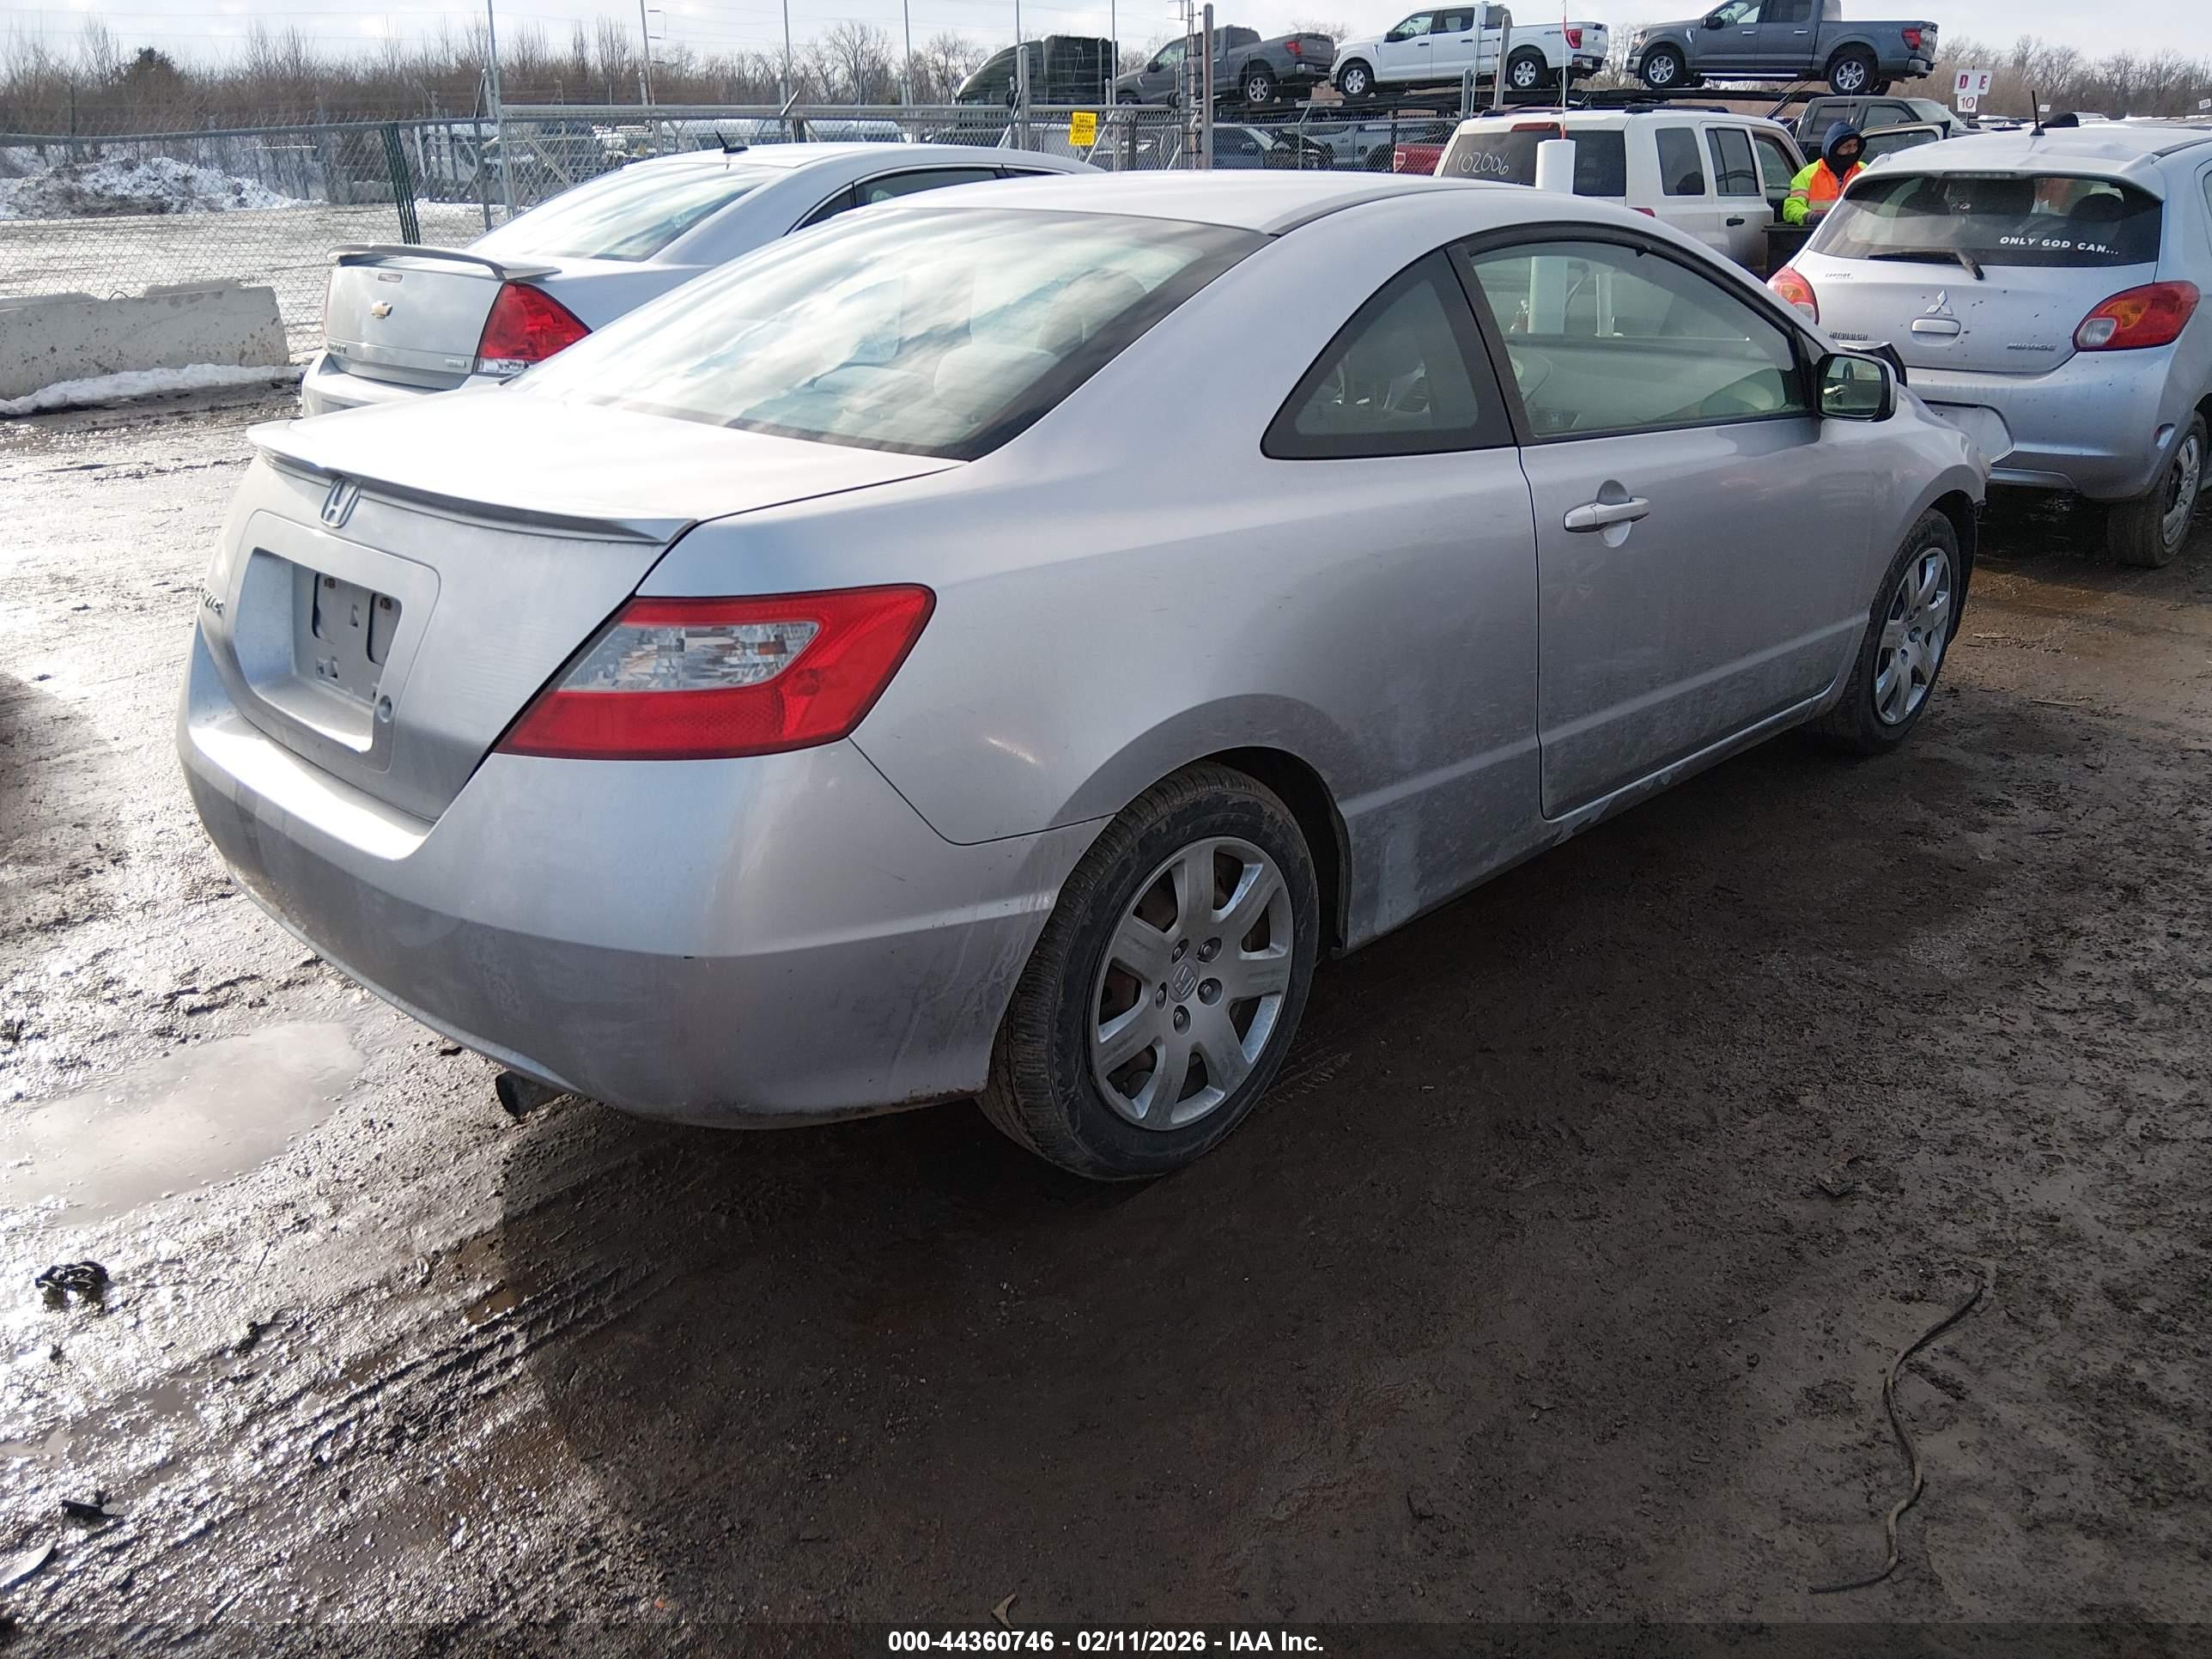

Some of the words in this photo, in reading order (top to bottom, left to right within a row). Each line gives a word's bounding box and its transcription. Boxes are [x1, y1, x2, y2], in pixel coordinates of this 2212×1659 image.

[1959, 74, 1969, 89] D
[1978, 75, 1988, 90] E
[1960, 96, 1976, 109] 10
[1456, 151, 1511, 175] 102006
[1999, 236, 2036, 246] ONLY
[2041, 239, 2071, 248] GOD
[2077, 242, 2119, 255] CAN...
